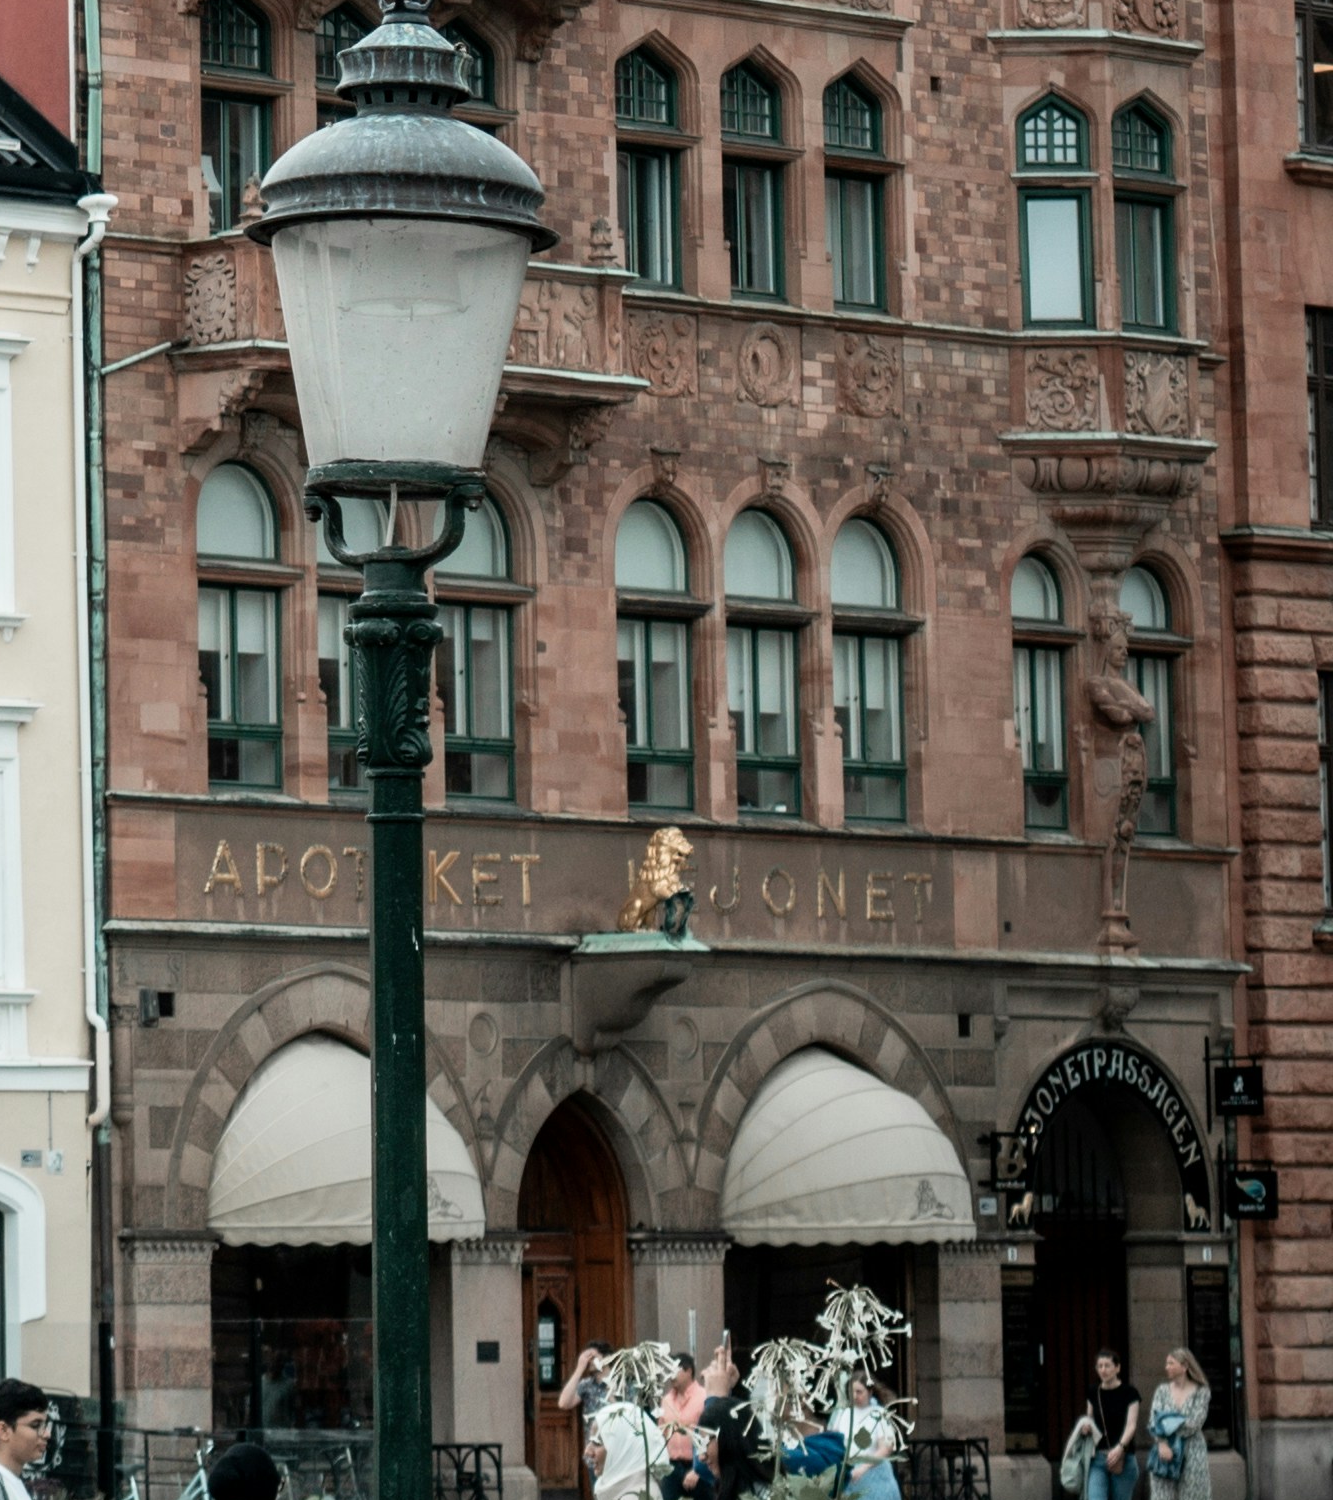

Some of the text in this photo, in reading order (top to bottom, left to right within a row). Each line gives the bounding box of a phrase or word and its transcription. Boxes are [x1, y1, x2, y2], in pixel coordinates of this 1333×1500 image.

[203, 839, 933, 927] APOTKET JONET
[1019, 1047, 1202, 1169] JONETPASSAGEN
